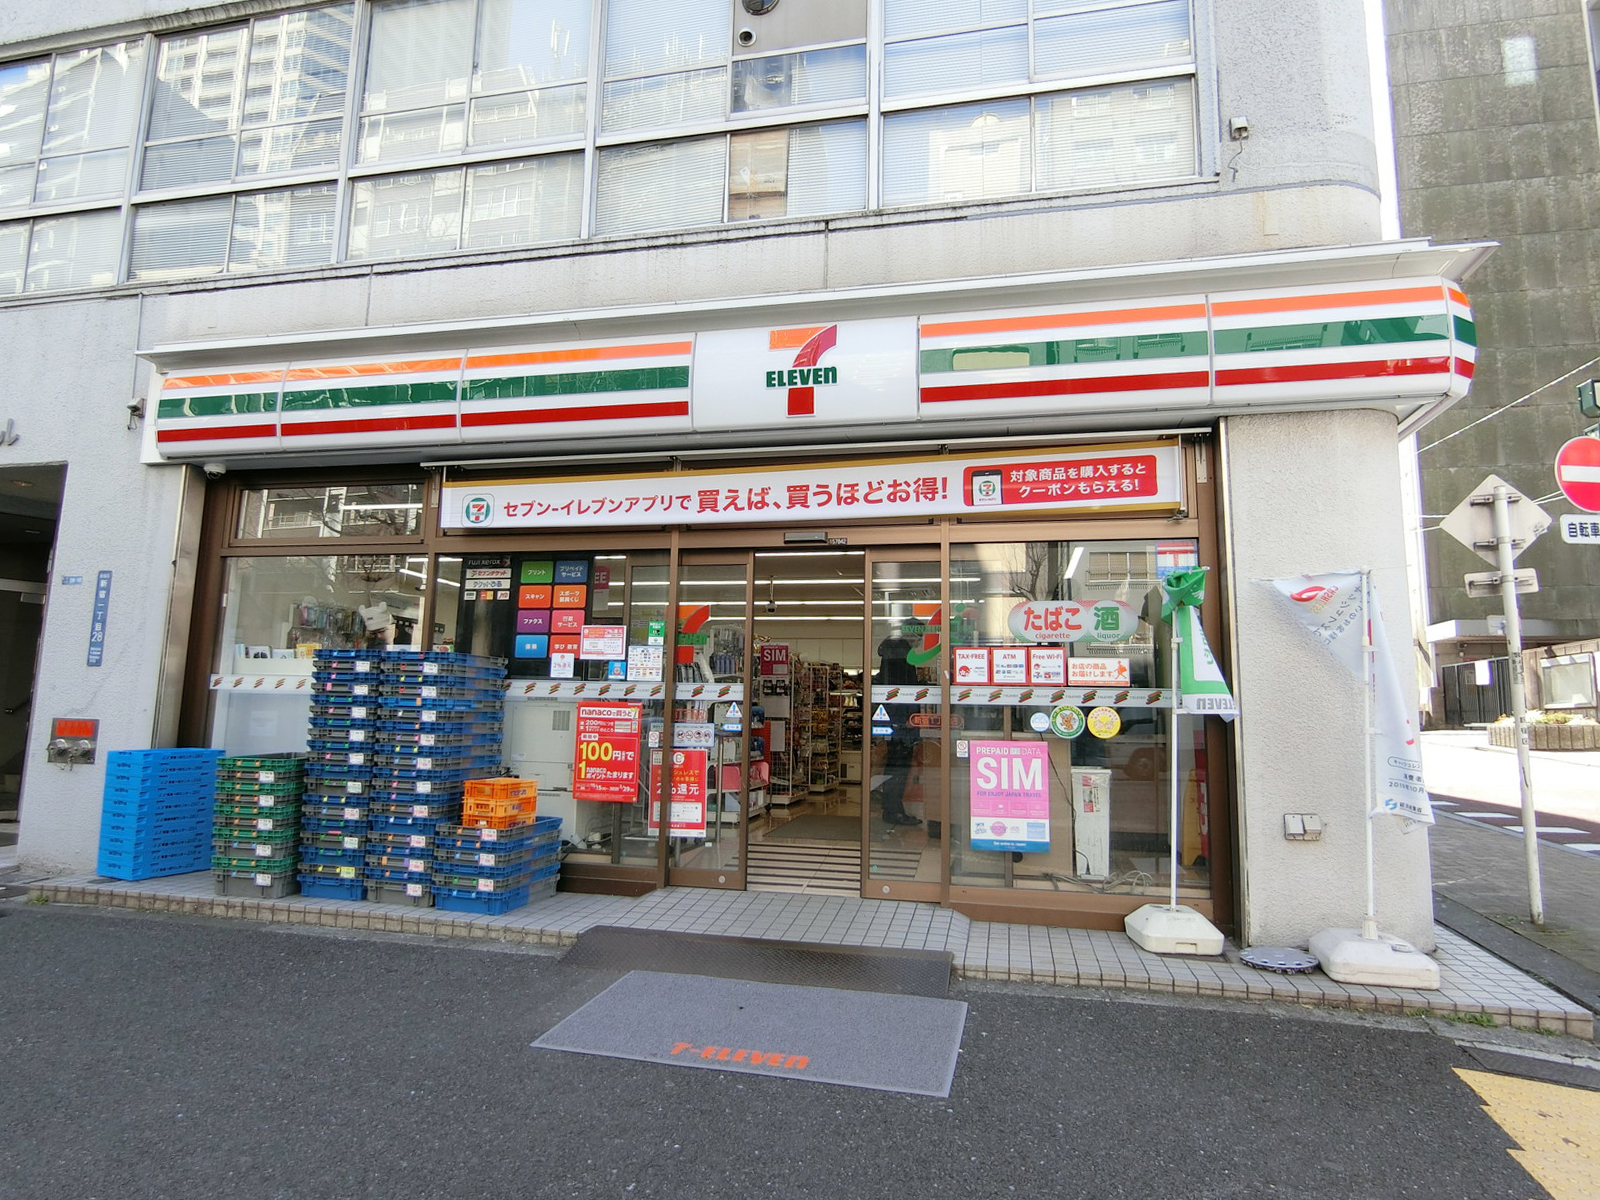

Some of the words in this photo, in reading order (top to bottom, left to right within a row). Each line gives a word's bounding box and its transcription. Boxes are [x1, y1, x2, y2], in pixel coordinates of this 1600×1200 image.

[1010, 463, 1147, 483] 対象商品を購入すると
[1018, 479, 1140, 498] クーポンもらえる!
[1568, 522, 1600, 538] 自転車
[95, 579, 108, 631] 新宿一丁目
[1024, 606, 1082, 631] たばこ
[1094, 606, 1120, 631] 酒
[91, 631, 103, 642] 28
[1097, 632, 1120, 640] liquor
[763, 649, 787, 661] SIM
[1071, 662, 1108, 670] お店の商品
[976, 746, 1009, 755] PREPAID
[1021, 747, 1042, 755] DATA
[578, 760, 586, 779] 1
[606, 771, 634, 779] たまります
[976, 756, 1043, 790] SIM
